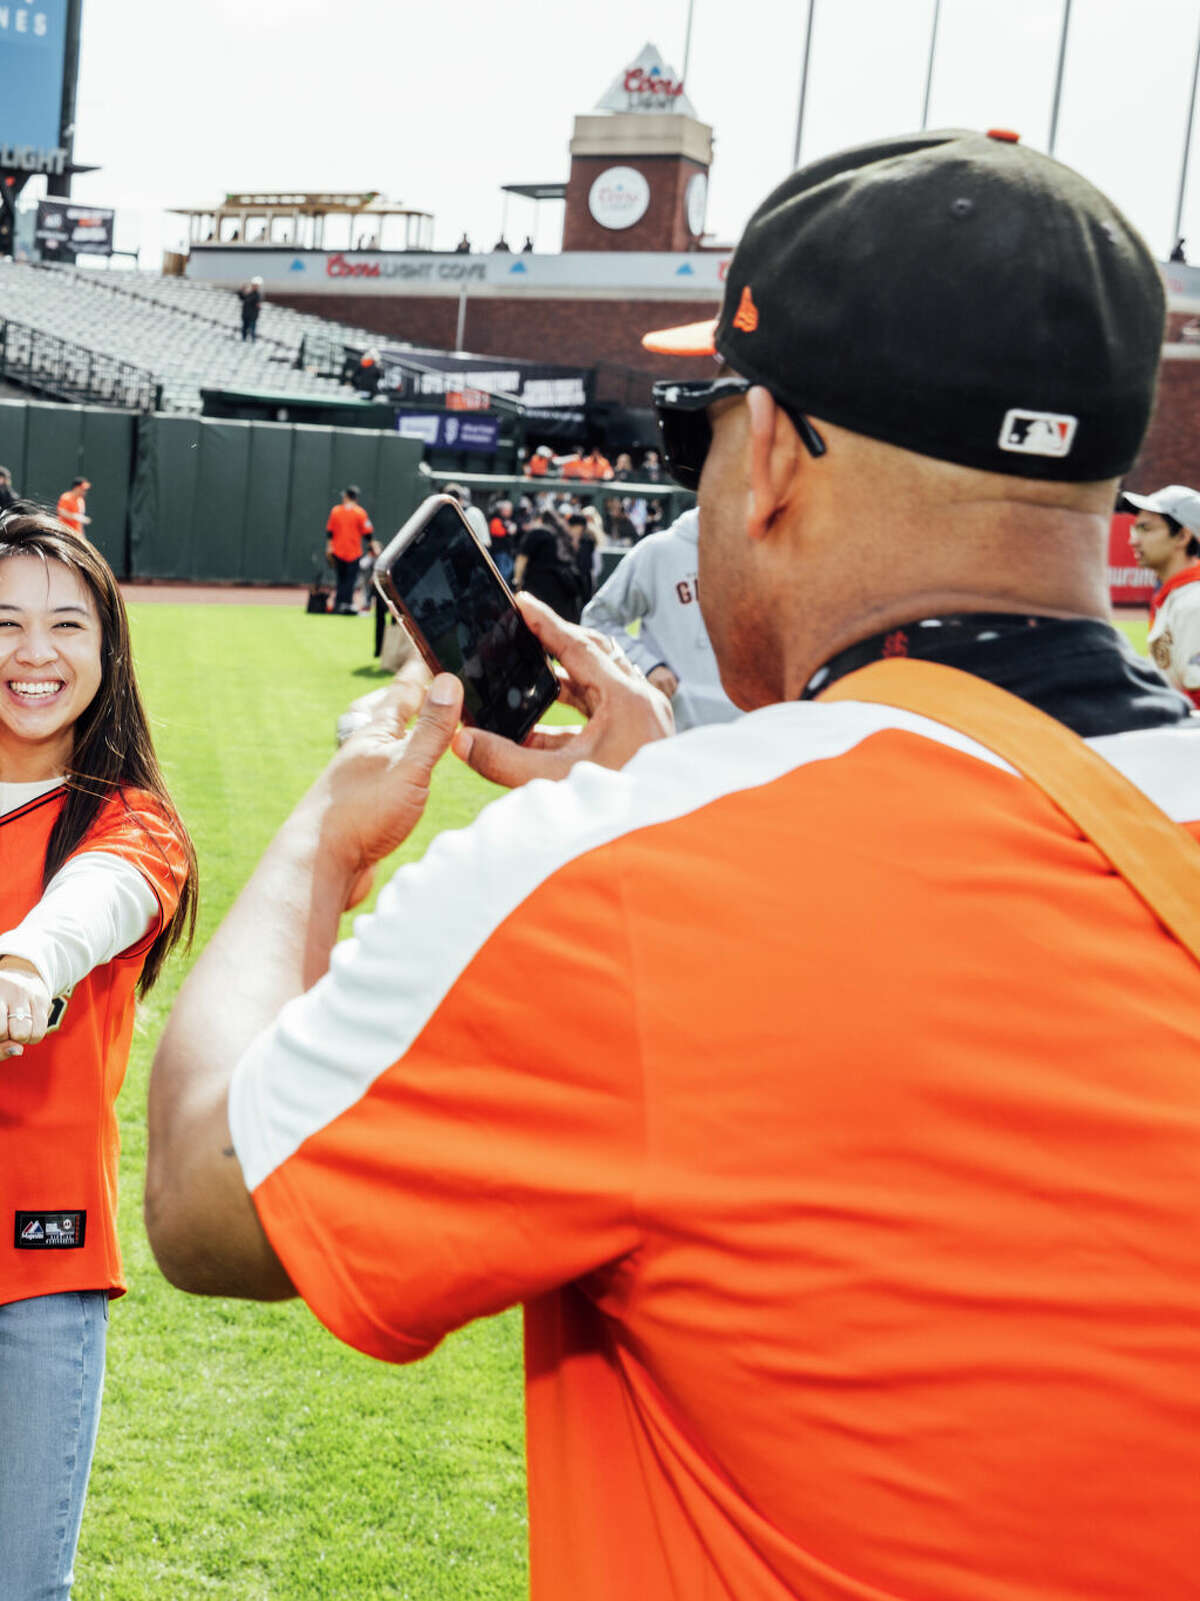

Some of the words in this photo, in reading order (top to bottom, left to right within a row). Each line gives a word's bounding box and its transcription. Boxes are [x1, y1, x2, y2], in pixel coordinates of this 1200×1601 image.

[623, 68, 684, 97] Coors
[1, 143, 69, 174] LIGHT
[326, 253, 381, 278] Coors
